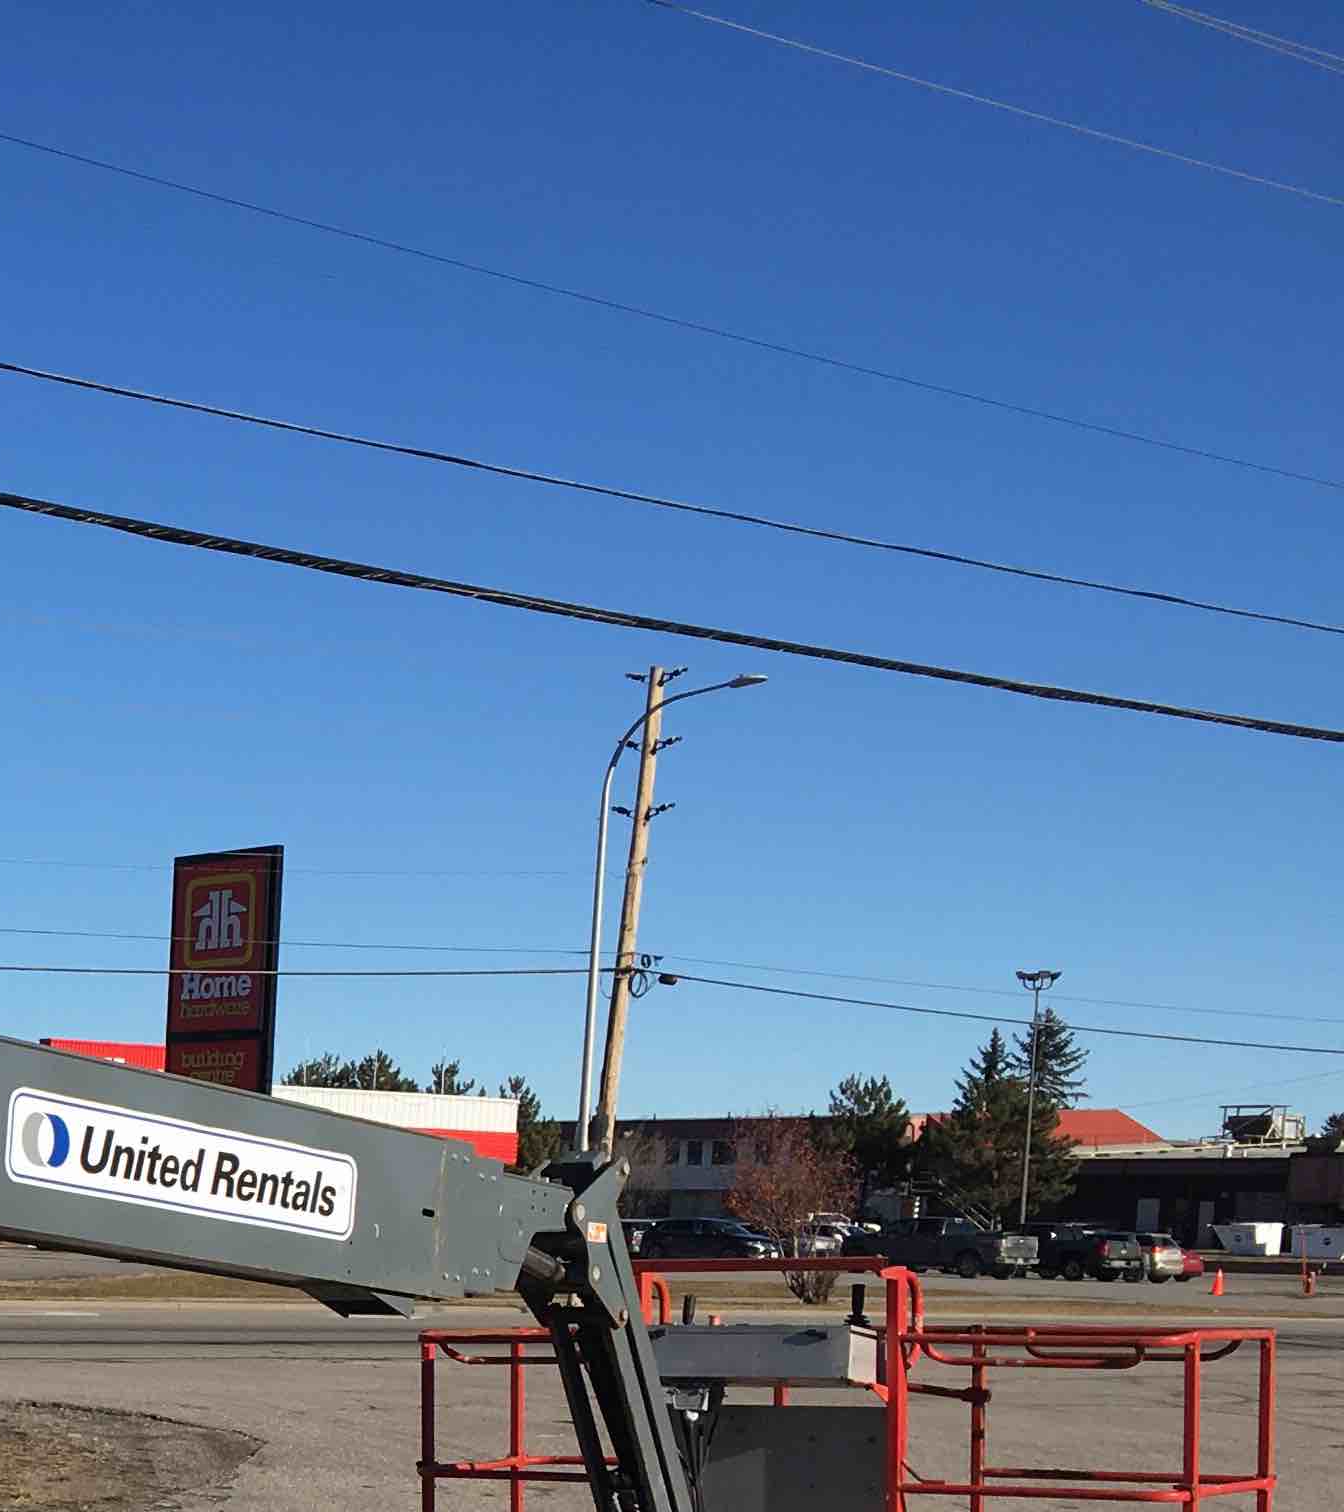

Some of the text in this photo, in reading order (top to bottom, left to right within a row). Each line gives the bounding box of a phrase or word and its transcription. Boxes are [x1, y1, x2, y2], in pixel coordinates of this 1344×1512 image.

[180, 973, 252, 1000] Home
[82, 1124, 337, 1217] United Rentals
